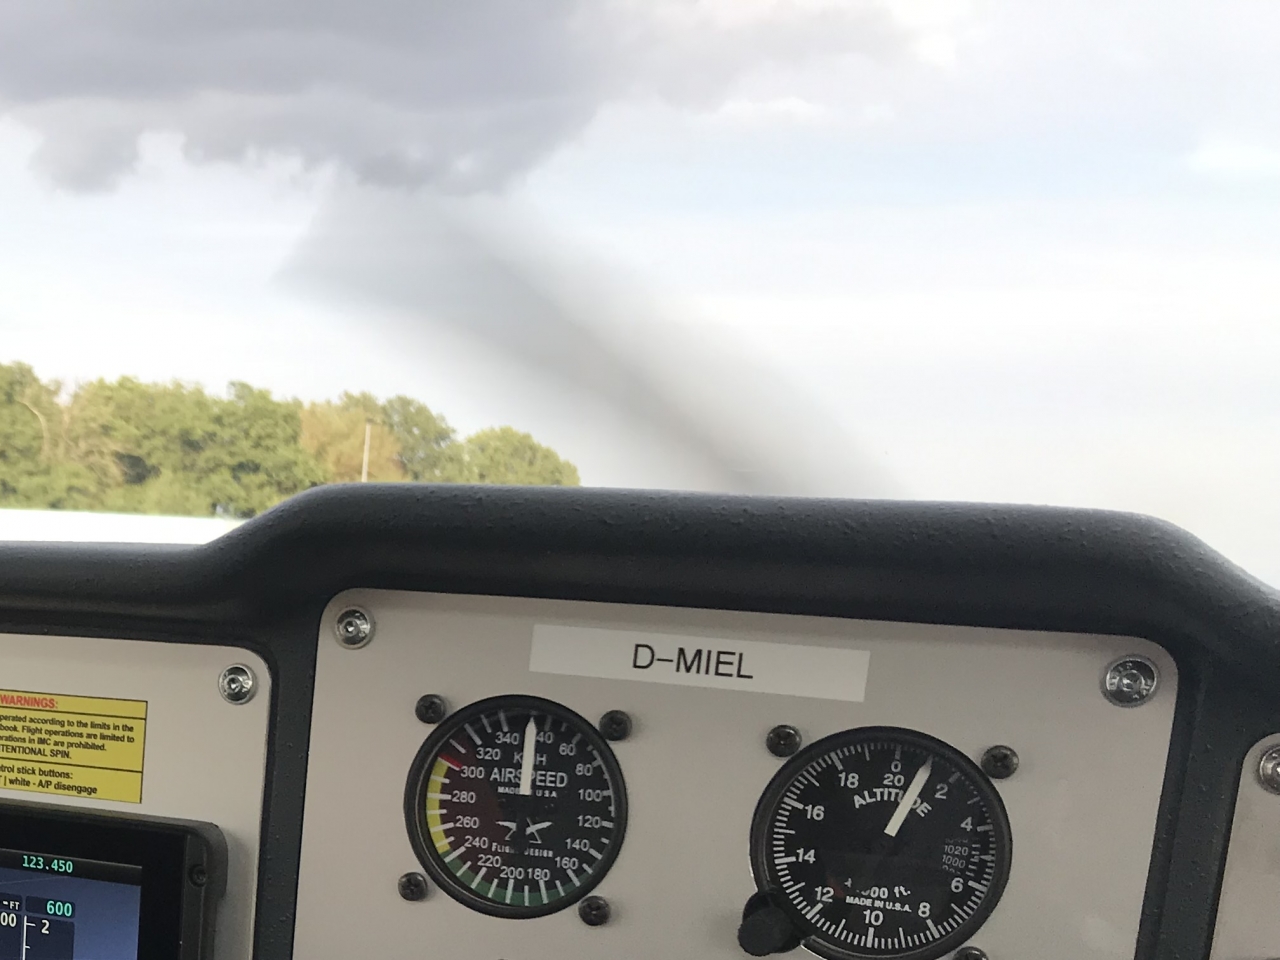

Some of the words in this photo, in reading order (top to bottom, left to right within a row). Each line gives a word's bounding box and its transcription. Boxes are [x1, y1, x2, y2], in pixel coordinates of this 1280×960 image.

[632, 643, 754, 680] D-MIEL
[0, 694, 58, 709] WARNINGS:
[28, 716, 66, 728] according
[66, 719, 75, 727] to
[76, 720, 89, 729] the
[90, 721, 111, 731] limits
[112, 723, 120, 732] in
[121, 724, 134, 733] the
[21, 725, 43, 736] Flight
[44, 728, 84, 739] operations
[85, 732, 98, 740] are
[99, 732, 126, 743] limited
[126, 735, 135, 743] to
[495, 731, 520, 745] 340
[28, 736, 36, 744] in
[37, 736, 52, 746] IMC
[52, 739, 65, 748] are
[66, 741, 107, 752] prohibited.
[558, 742, 576, 756] 60
[49, 748, 72, 760] SPIN.
[476, 747, 501, 761] 320
[16, 766, 37, 776] stick
[38, 767, 74, 780] buttons:
[460, 766, 485, 779] 300
[575, 763, 593, 777] 80
[8, 777, 31, 787] white
[37, 779, 53, 789] A/P
[54, 781, 98, 796] disengage
[838, 772, 859, 789] 18
[883, 773, 905, 786] 20
[451, 790, 476, 803] 280
[578, 789, 602, 802] 100
[805, 805, 825, 821] 16
[455, 816, 479, 829] 260
[577, 815, 602, 828] 120
[464, 835, 488, 849] 240
[565, 838, 591, 851] 140
[796, 848, 816, 864] 14
[944, 844, 969, 856] 1020
[22, 855, 74, 873] 123.450
[477, 854, 502, 868] 220
[554, 856, 579, 870] 160
[942, 854, 966, 869] 1000
[500, 866, 524, 880] 200
[526, 867, 551, 881] 180
[814, 886, 835, 902] 12
[46, 900, 73, 917] 600
[845, 895, 873, 907] MADE
[874, 900, 884, 908] IN
[863, 909, 884, 926] 10
